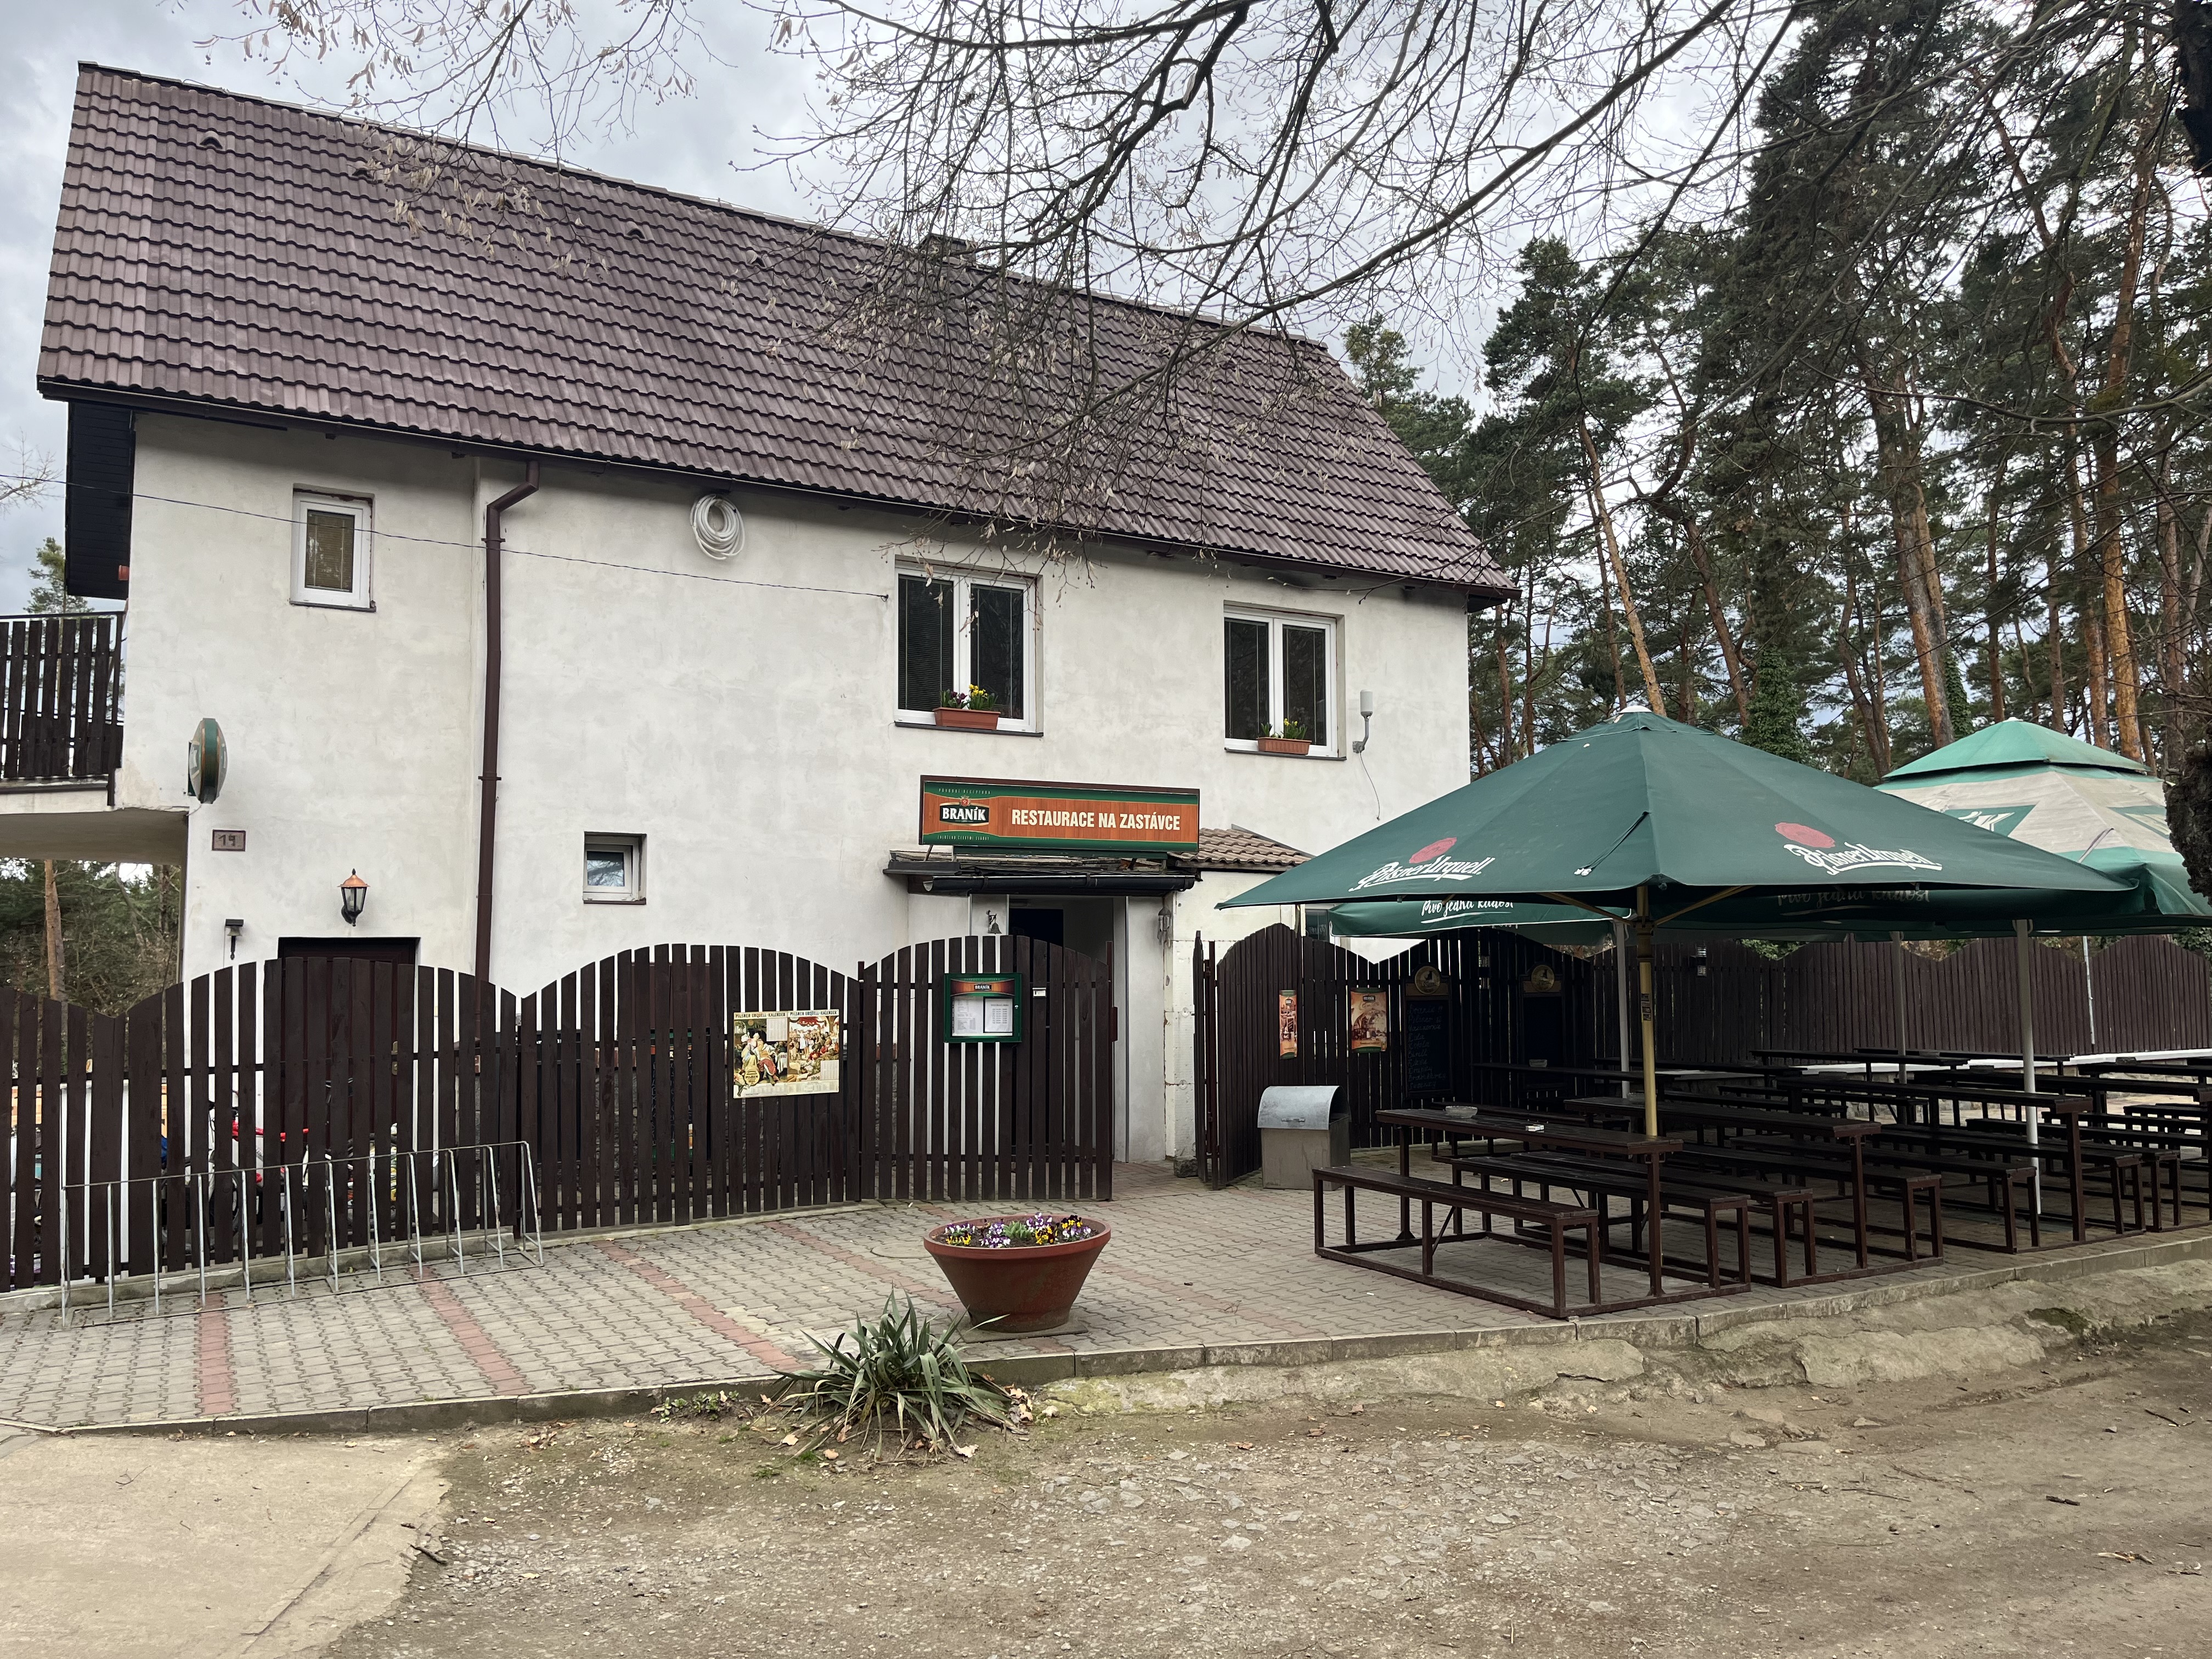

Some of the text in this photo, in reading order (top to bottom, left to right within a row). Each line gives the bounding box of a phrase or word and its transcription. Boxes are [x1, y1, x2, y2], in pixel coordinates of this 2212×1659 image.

[942, 806, 986, 821] BRANÍK
[1012, 809, 1181, 831] RESTAURACE NA ZASTÁVCE
[218, 834, 236, 847] 19
[1783, 844, 1866, 876] Pilsner
[1348, 861, 1432, 892] Pilsner
